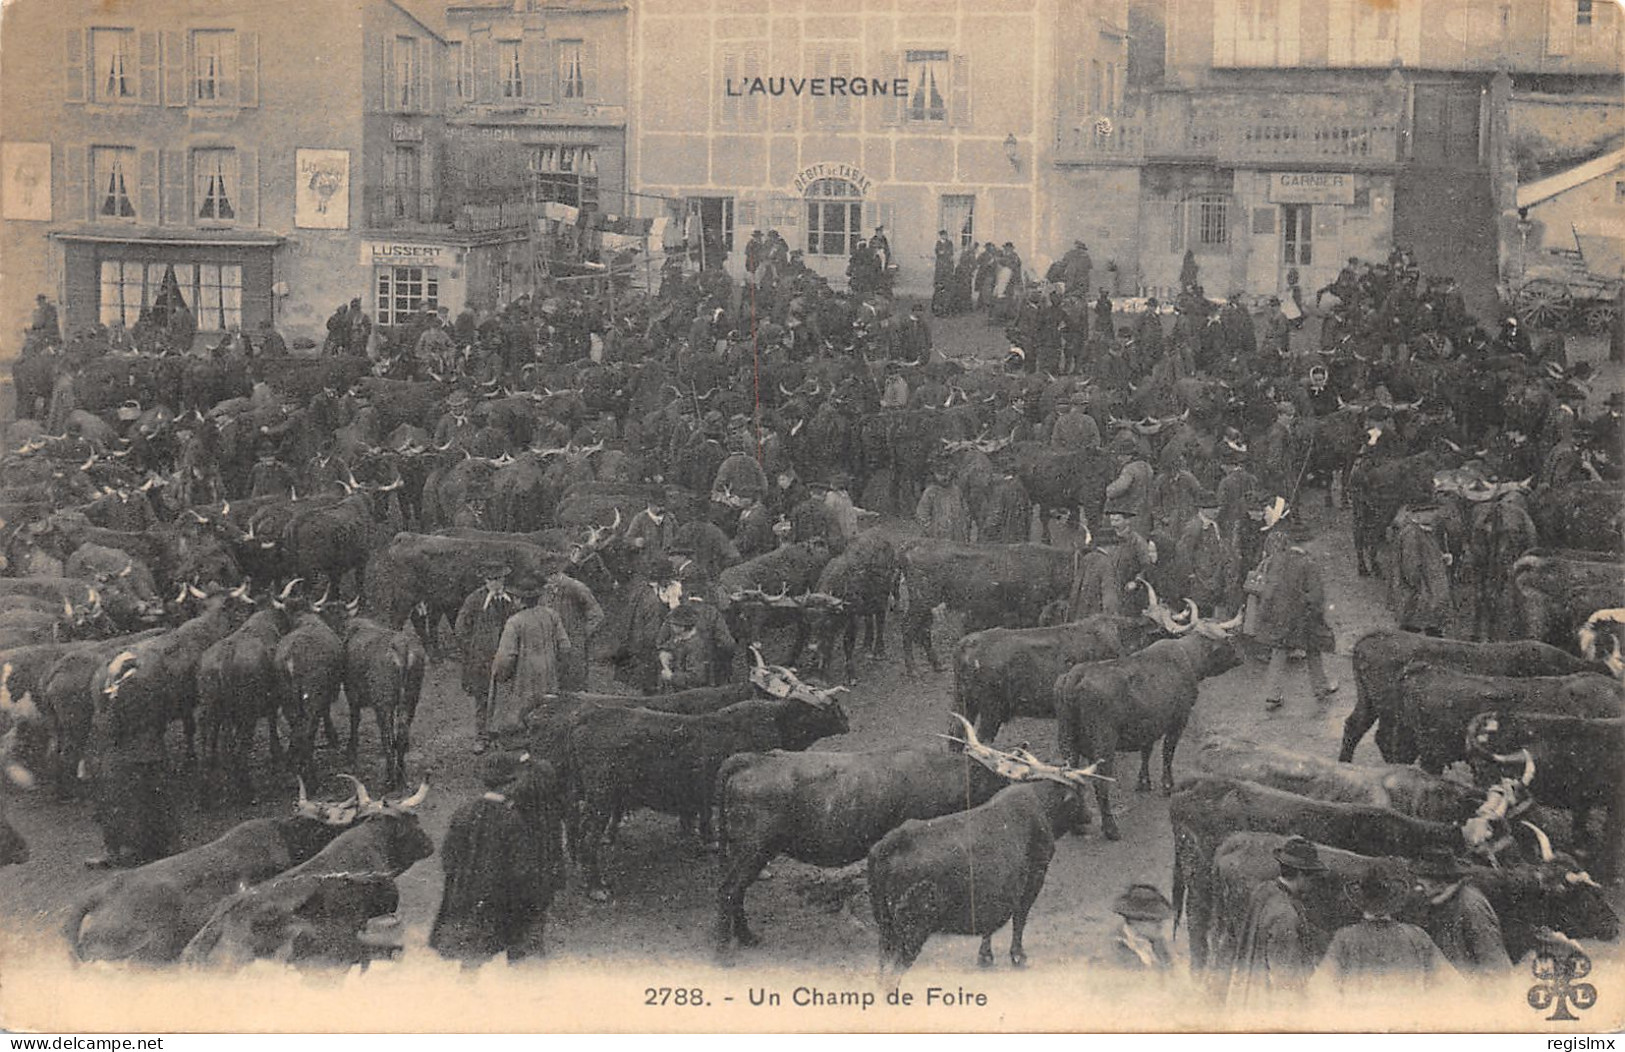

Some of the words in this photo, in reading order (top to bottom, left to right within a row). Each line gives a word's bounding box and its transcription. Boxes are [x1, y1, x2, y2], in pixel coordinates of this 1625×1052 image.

[727, 77, 909, 97] L'AUVERGNE
[839, 165, 871, 195] TABAC
[372, 245, 443, 256] LUSSERT
